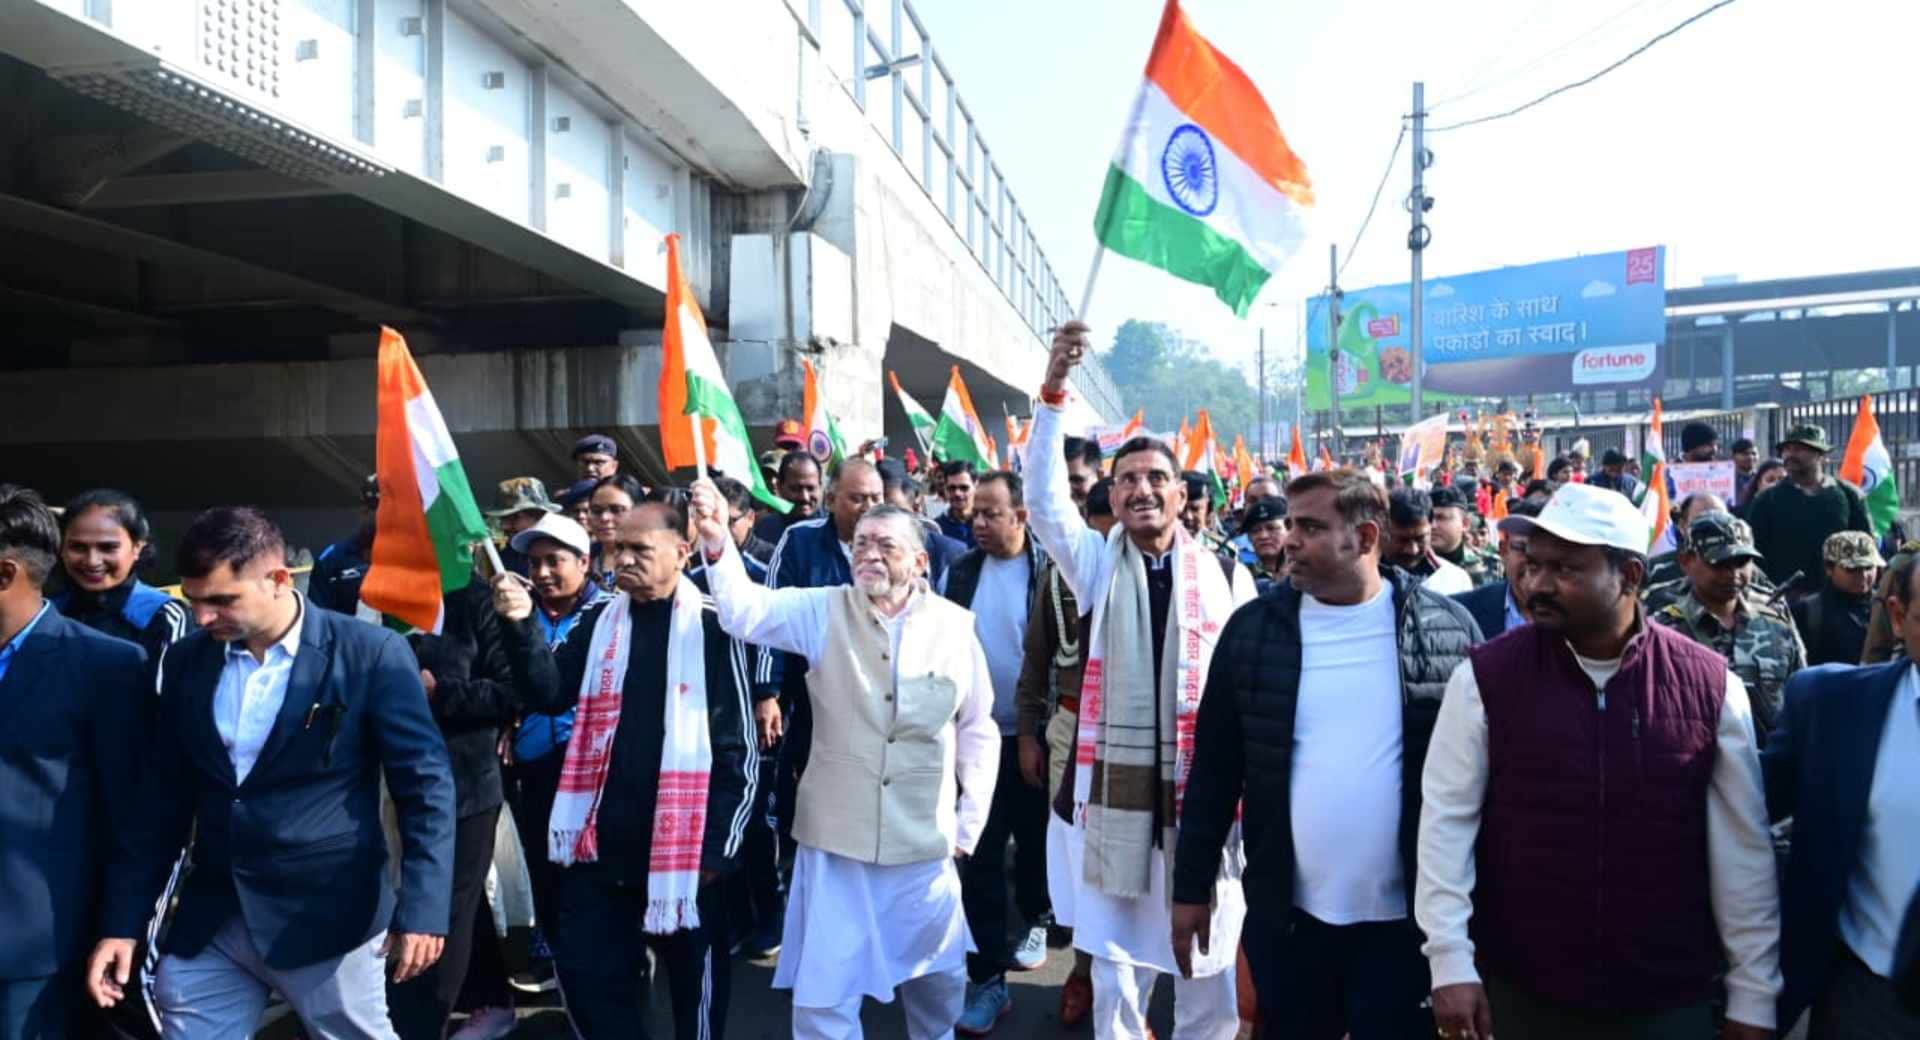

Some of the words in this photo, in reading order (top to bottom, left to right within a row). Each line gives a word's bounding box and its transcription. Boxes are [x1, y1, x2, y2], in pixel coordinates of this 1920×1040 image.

[1630, 255, 1653, 275] 25
[1489, 297, 1510, 319] के
[1517, 295, 1559, 317] साथ
[1496, 328, 1521, 346] का
[1582, 353, 1645, 368] fortune
